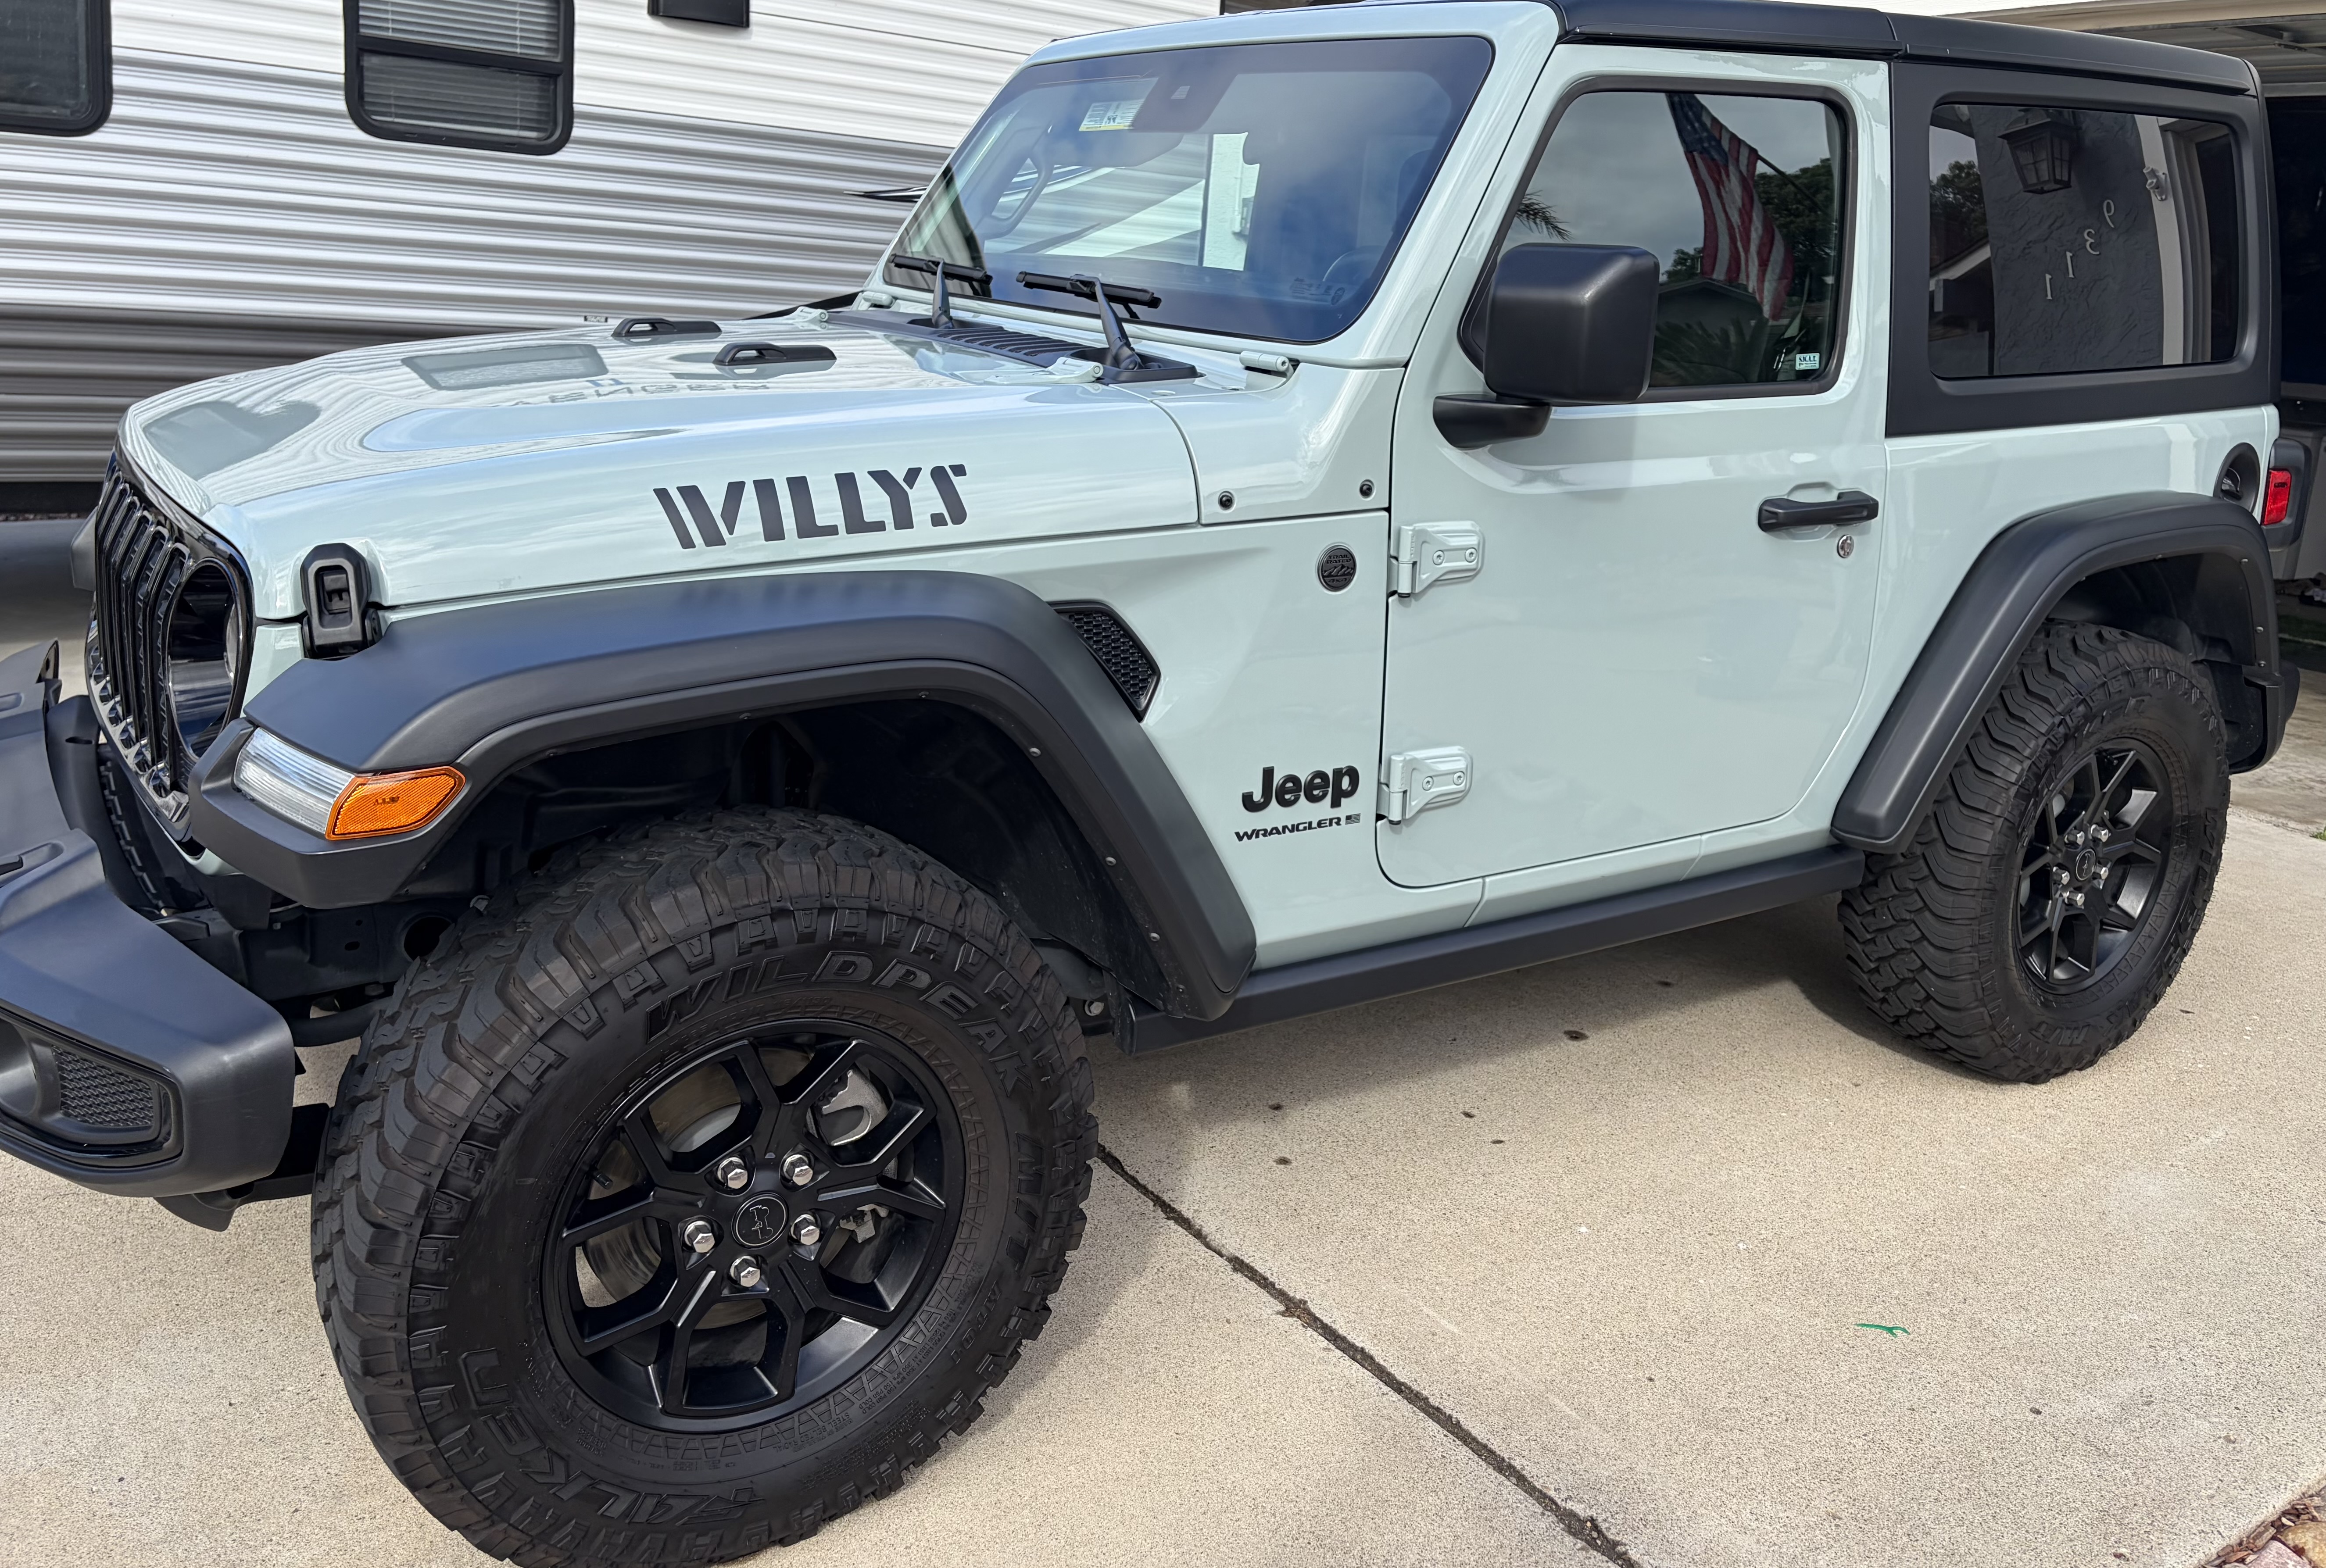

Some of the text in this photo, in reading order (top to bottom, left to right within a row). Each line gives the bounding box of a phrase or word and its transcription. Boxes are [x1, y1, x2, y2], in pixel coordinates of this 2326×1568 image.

[653, 464, 967, 550] WILLYS
[1242, 765, 1360, 813] Jeep
[1234, 816, 1342, 842] WRANGLER
[646, 950, 1034, 1097] WILDPEAK
[910, 1355, 919, 1363] AT
[914, 1358, 923, 1367] AT
[901, 1361, 913, 1373] 350
[905, 1365, 917, 1377] 350
[882, 1380, 893, 1390] (50
[857, 1396, 873, 1410] COLD
[861, 1401, 877, 1415] COLD
[459, 1347, 766, 1526] FALKEN
[772, 1412, 850, 1454] STEEL BELTED RADIAL
